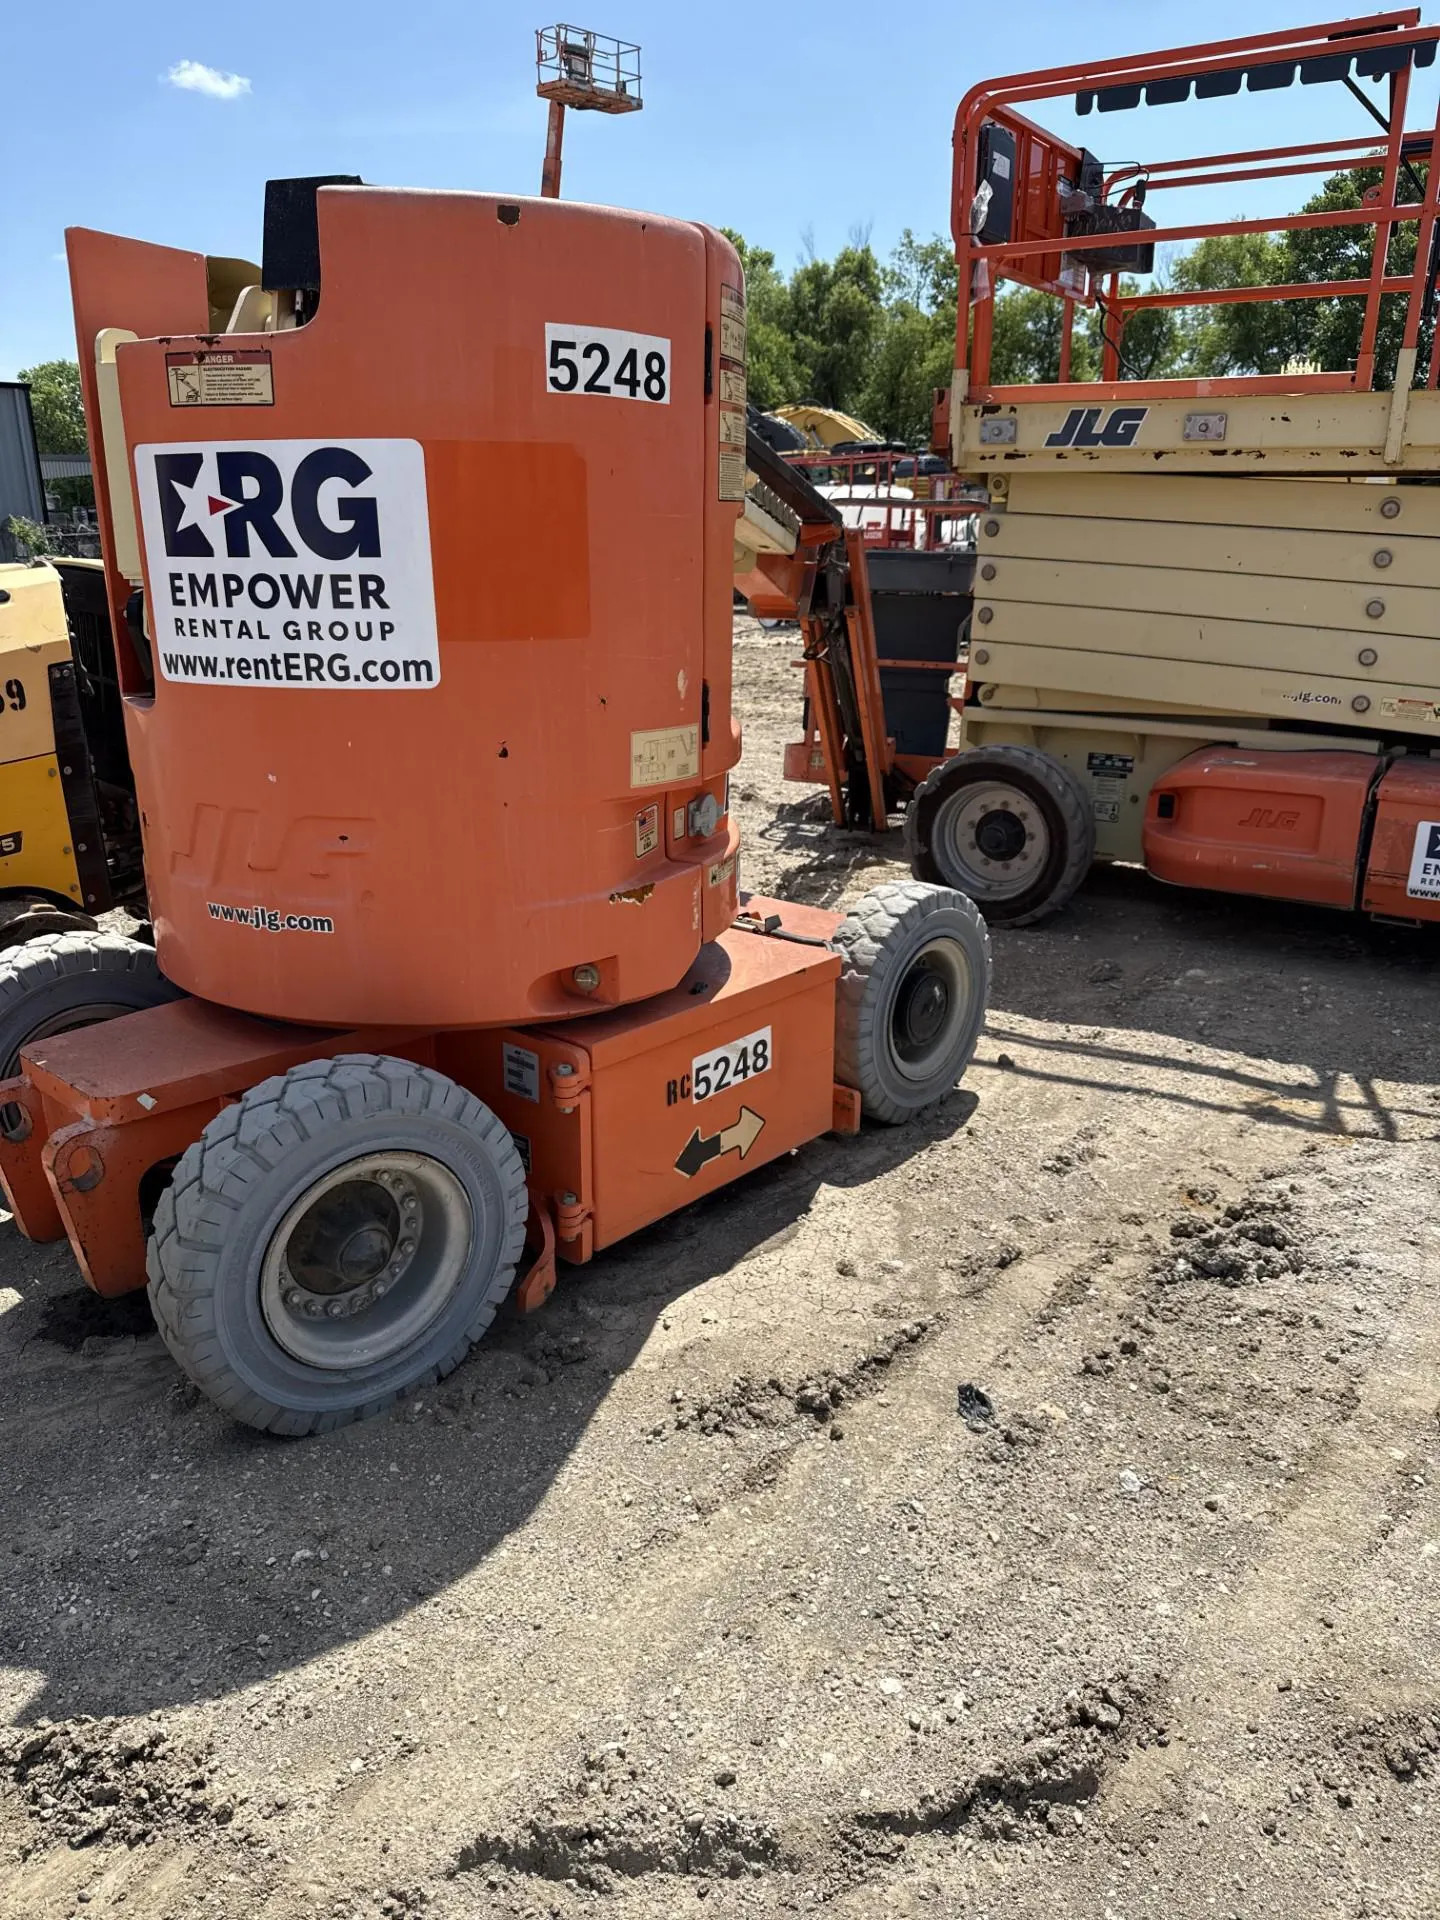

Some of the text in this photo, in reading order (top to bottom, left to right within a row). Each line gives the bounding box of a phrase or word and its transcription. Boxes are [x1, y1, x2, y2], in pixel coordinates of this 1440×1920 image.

[199, 354, 234, 364] ANGER
[549, 339, 666, 401] 5248
[1043, 407, 1149, 447] JLG
[154, 447, 382, 561] ERG
[169, 573, 391, 609] EMPOWER
[174, 617, 395, 641] RENTAL GROUP
[163, 652, 434, 682] www.rentERG.com
[0, 678, 26, 714] 9
[0, 837, 15, 852] 5
[207, 903, 333, 932] www.jlg.com
[666, 1038, 768, 1106] RC 5248
